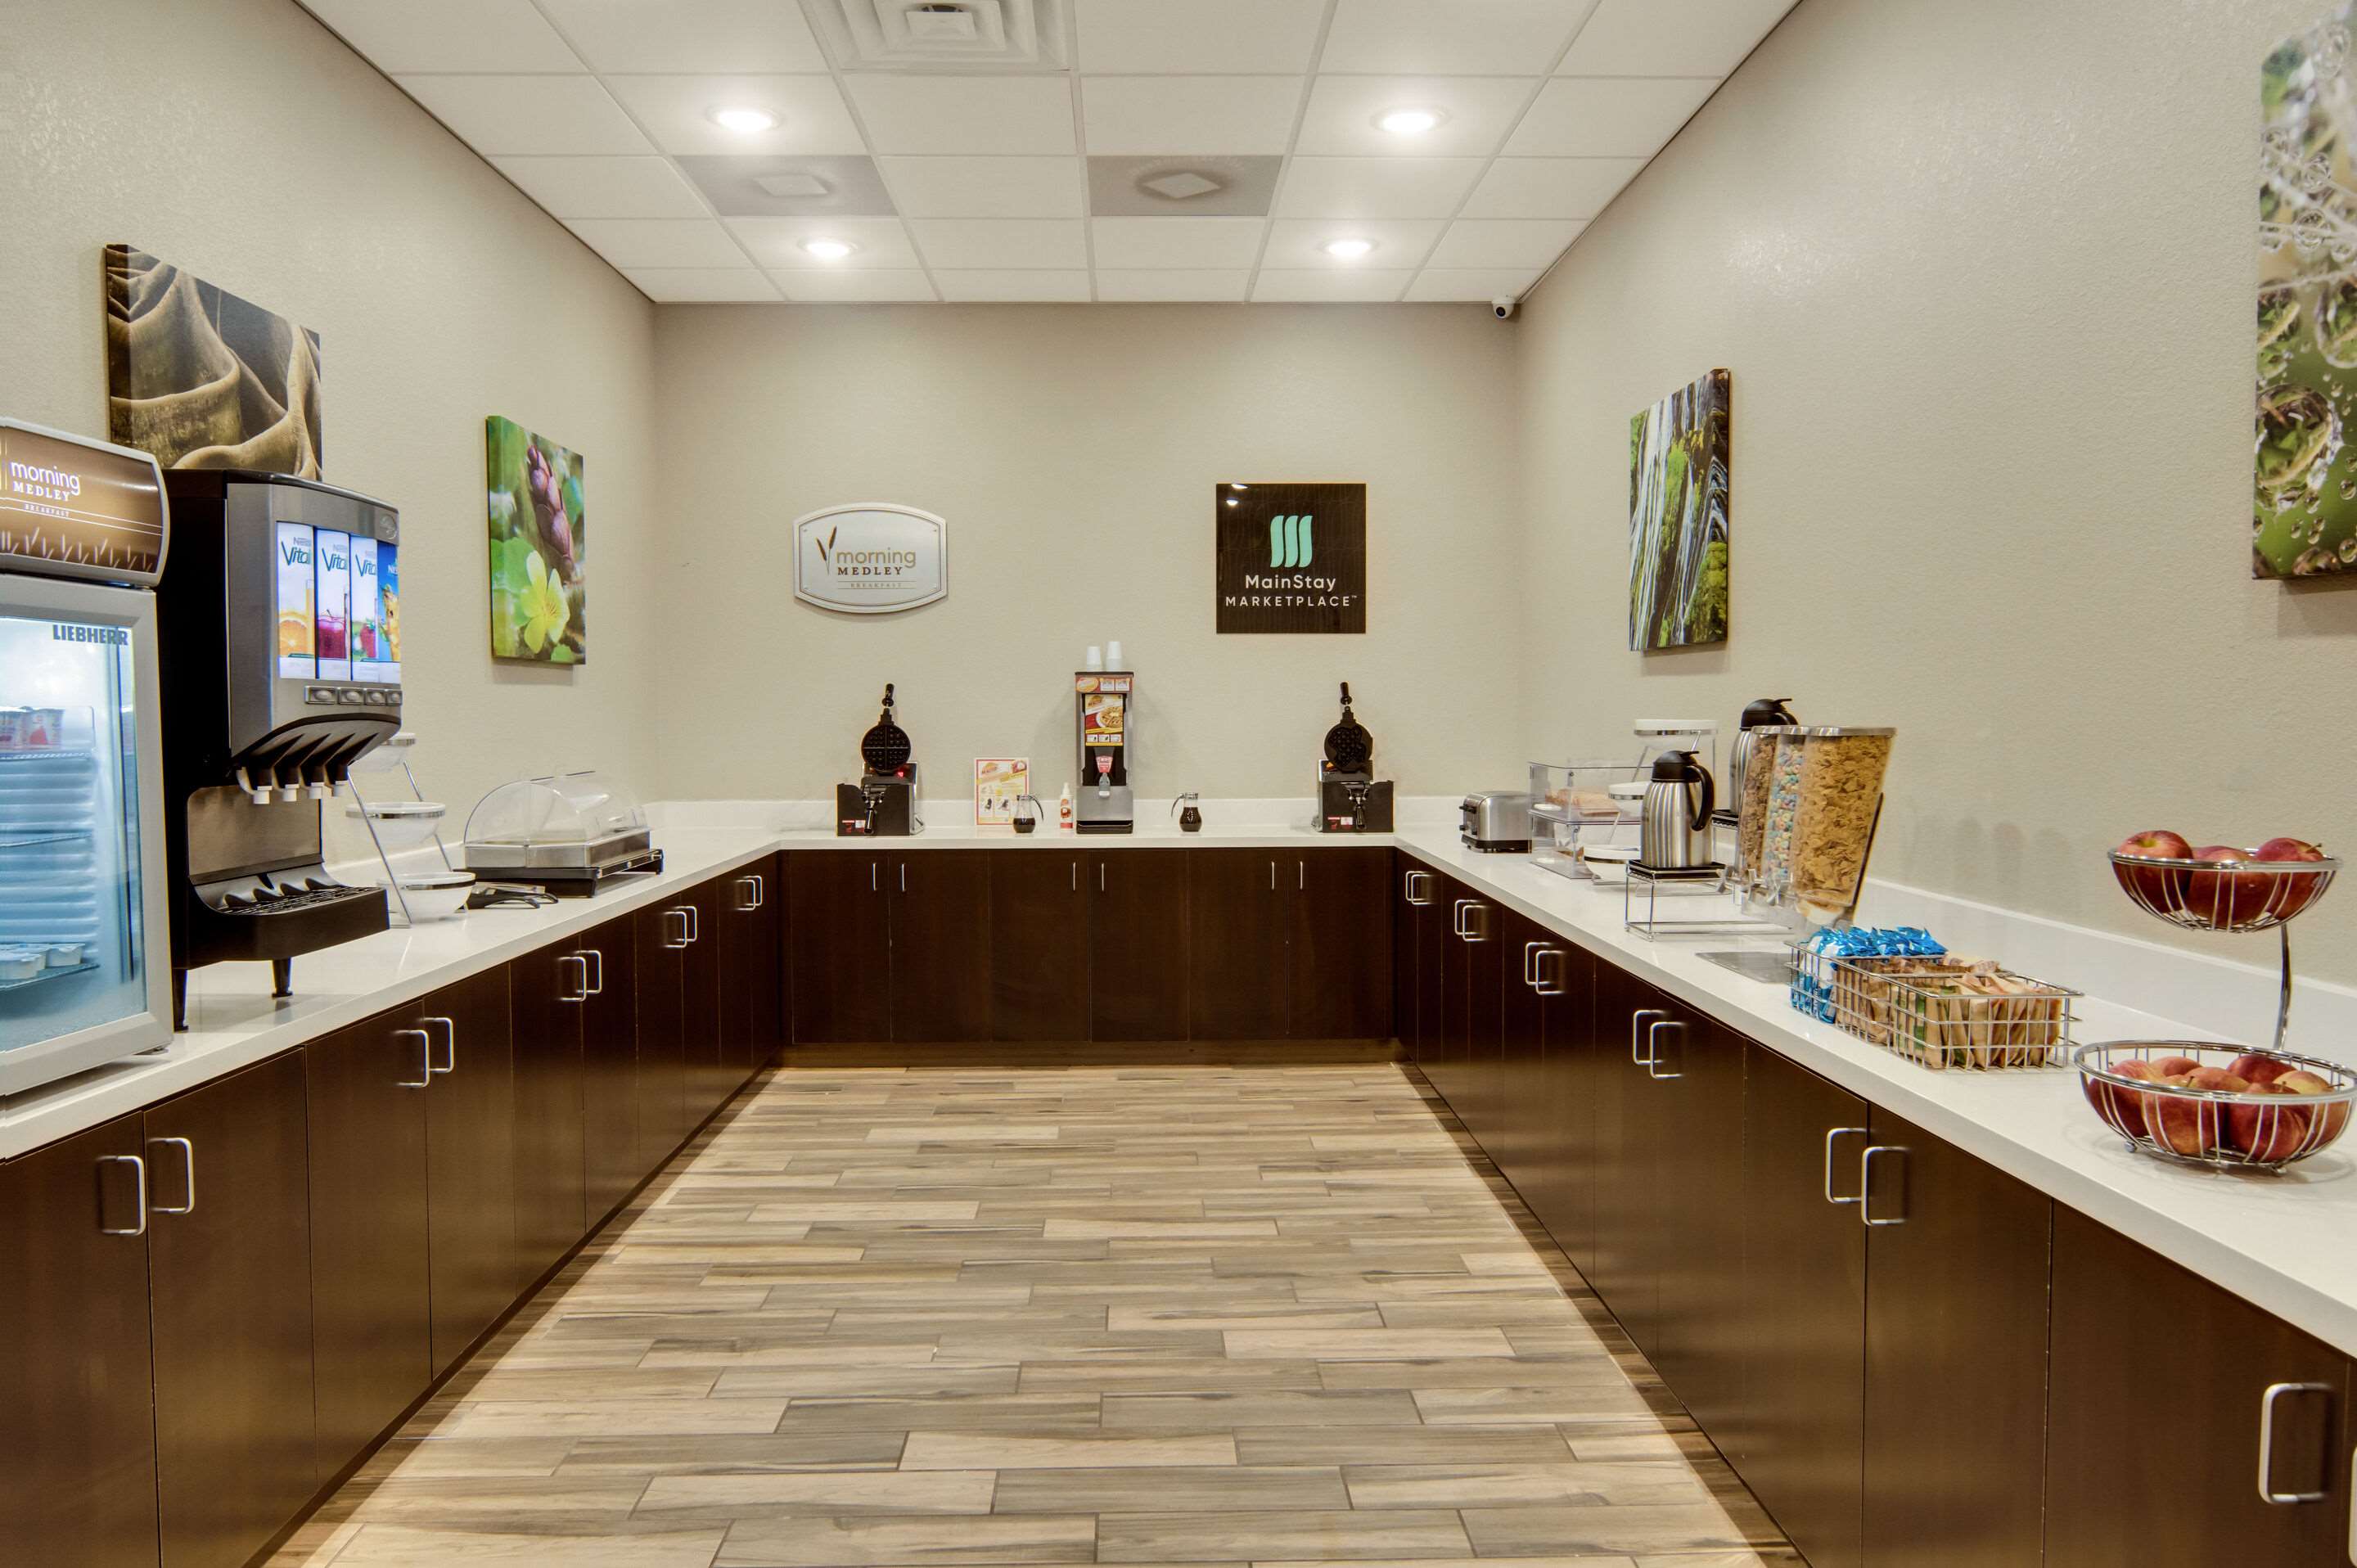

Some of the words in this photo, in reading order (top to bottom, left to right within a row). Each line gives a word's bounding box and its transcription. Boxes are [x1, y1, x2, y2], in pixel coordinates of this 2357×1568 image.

[10, 462, 81, 496] morning
[13, 480, 70, 502] MEDLEY
[836, 547, 917, 569] morning
[838, 566, 904, 576] MEDLEY
[1245, 574, 1336, 593] MainStay
[52, 624, 128, 646] LIEBHERR
